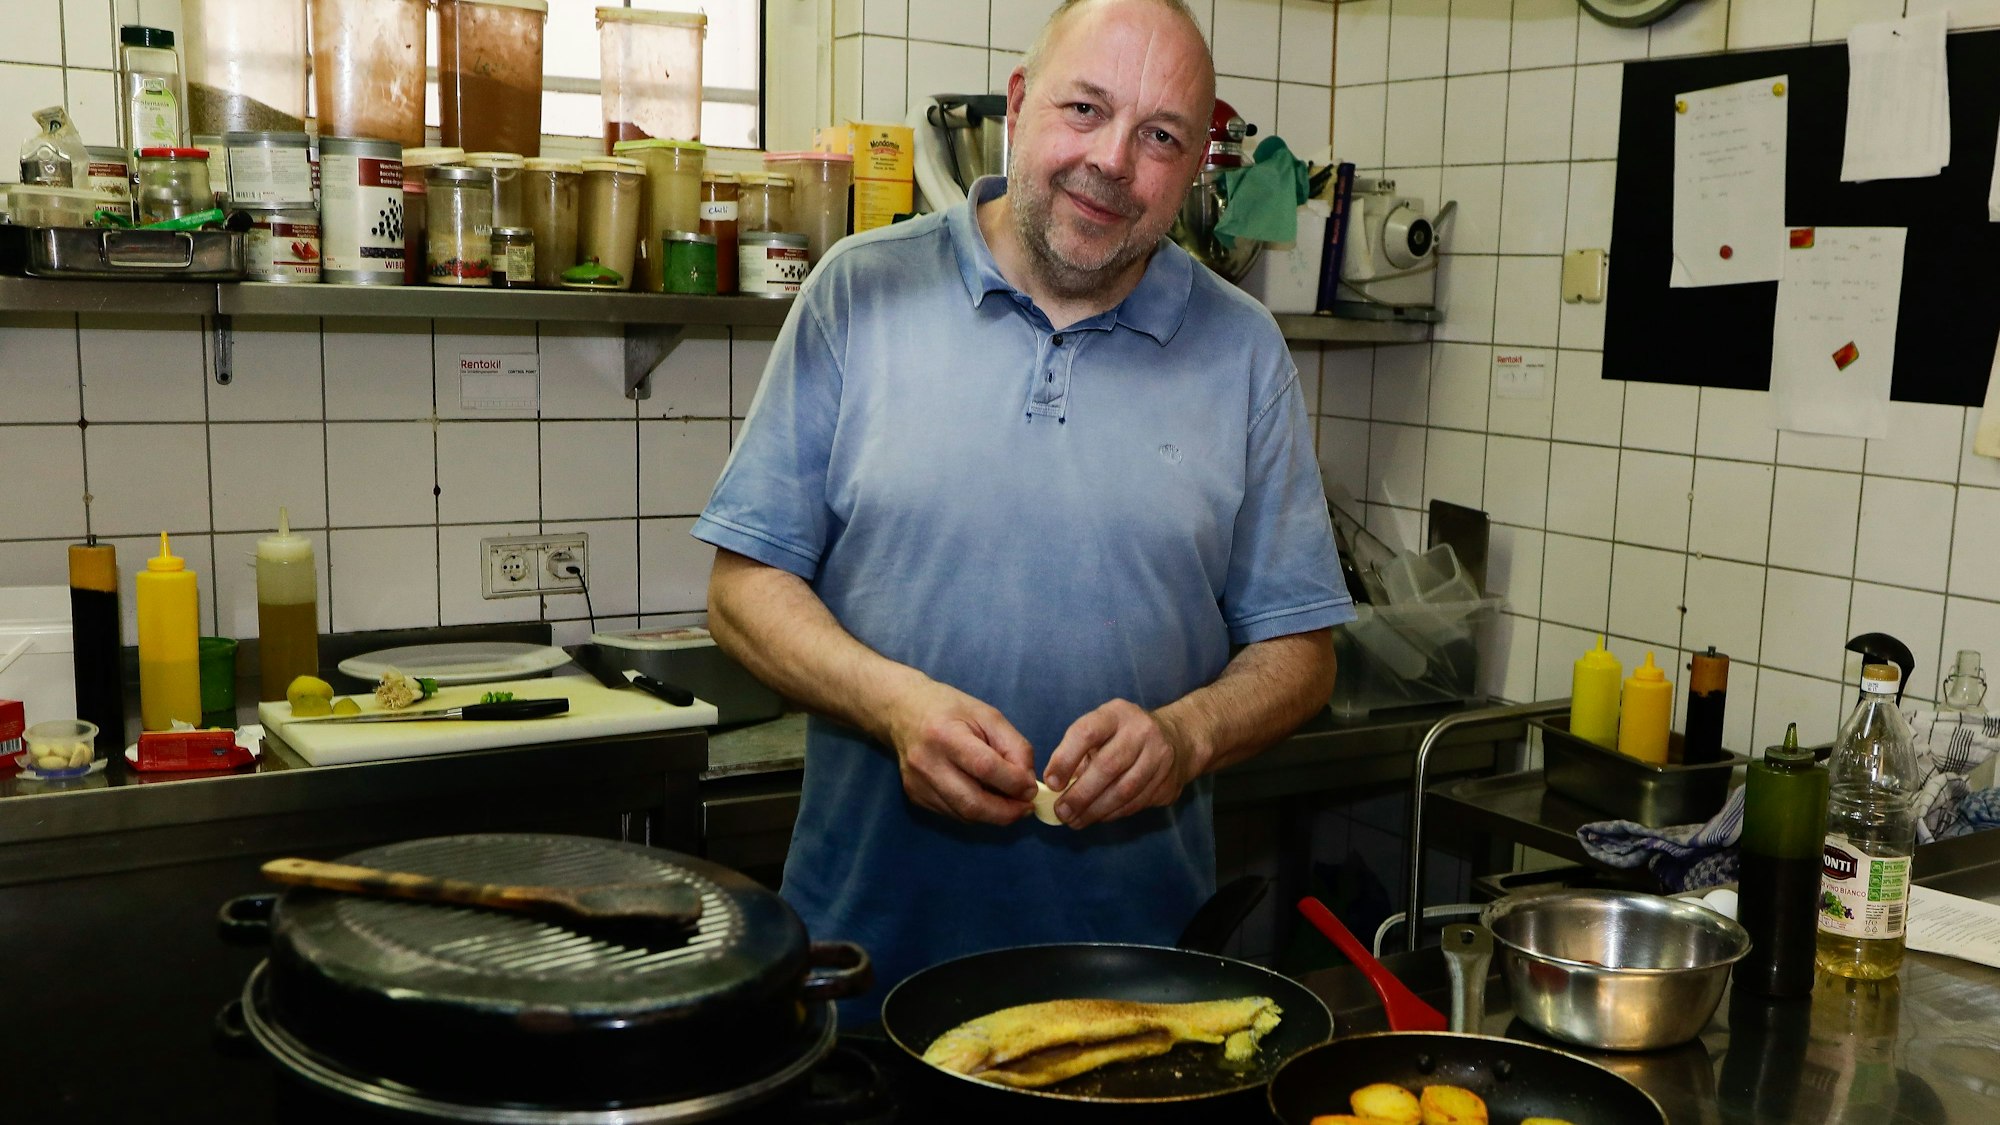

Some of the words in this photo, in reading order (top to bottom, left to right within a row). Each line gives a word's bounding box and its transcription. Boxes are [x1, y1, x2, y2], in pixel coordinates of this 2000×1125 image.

[870, 140, 899, 150] Mondamin
[461, 360, 501, 369] Rentokil
[1826, 884, 1839, 892] VINO
[1840, 888, 1866, 898] BIANCO
